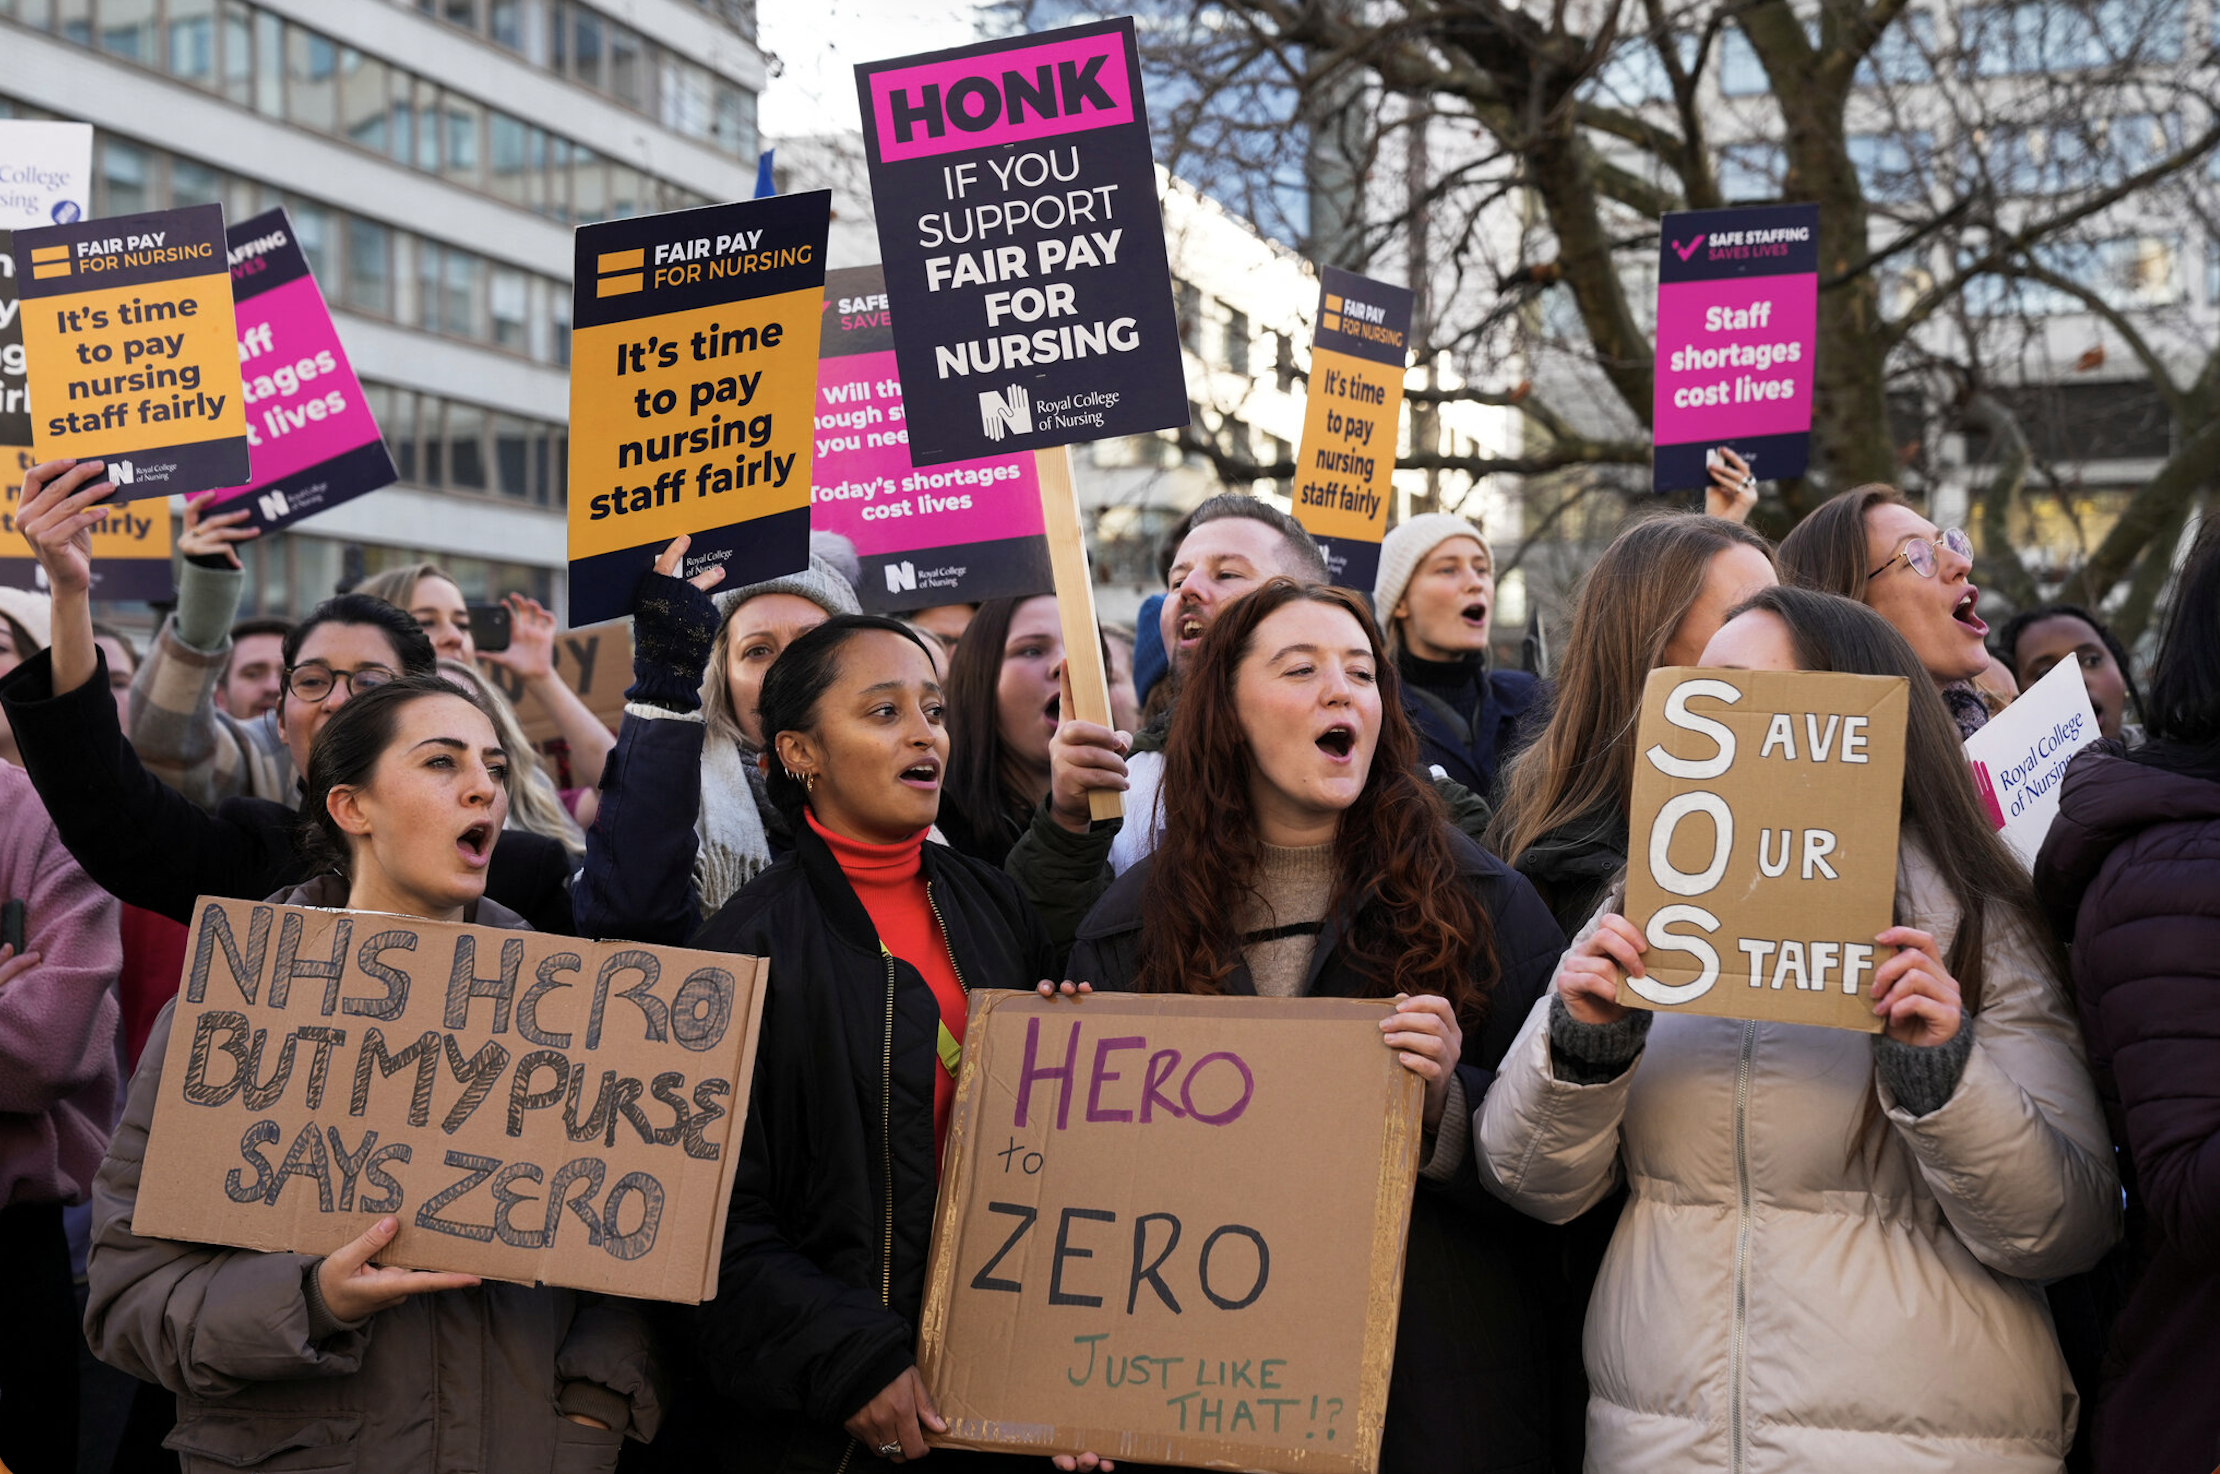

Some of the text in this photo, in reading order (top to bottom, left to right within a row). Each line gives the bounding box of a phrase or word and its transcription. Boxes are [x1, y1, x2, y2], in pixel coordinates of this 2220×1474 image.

[889, 54, 1118, 143] HONK
[944, 146, 1079, 200] IF YOU
[918, 184, 1118, 248] SUPPORT
[77, 232, 165, 257] FAIR PAY
[228, 230, 287, 265] AFFING
[655, 229, 763, 265] FAIR PAY
[1708, 243, 1788, 261] SAVES LIVES
[1709, 227, 1810, 247] SAFE STAFFING
[80, 243, 212, 273] FOR NURSING
[654, 244, 812, 289] FOR NURSING
[925, 228, 1123, 292] FAIR PAY
[119, 297, 198, 327] time
[838, 293, 889, 314] SAFE
[984, 283, 1078, 327] FOR
[1344, 298, 1386, 325] FAIR PAY
[1704, 301, 1772, 332] Staff
[841, 311, 891, 331] SAVE
[1342, 317, 1403, 348] FOR NURSING
[77, 333, 186, 365] to pay
[238, 321, 274, 363] aff
[691, 321, 783, 359] time
[934, 317, 1139, 379] NURSING
[1670, 342, 1802, 372] shortages
[69, 365, 200, 399] nursing
[242, 350, 337, 404] tages
[634, 371, 762, 417] to pay
[822, 379, 902, 404] Will th
[1350, 374, 1385, 405] time
[1674, 375, 1795, 409] cost lives
[49, 392, 227, 436] staff fairly
[262, 390, 347, 438] lives
[814, 405, 882, 429] nough
[1037, 390, 1120, 417] Royal College
[1038, 411, 1104, 431] of Nursing
[1327, 409, 1374, 446] to pay
[619, 413, 772, 468] nursing
[816, 429, 909, 458] you nee
[136, 463, 177, 476] Royal College
[144, 473, 169, 481] Nursing
[902, 463, 1020, 492] shortages
[1316, 449, 1375, 483] nursing
[589, 450, 796, 521] staff fairly
[1301, 482, 1381, 520] staff fairly
[862, 492, 973, 521] cost lives
[686, 567, 695, 577] of
[687, 549, 733, 566] Royal College
[918, 566, 967, 580] Royal College
[929, 578, 958, 588] Nursing
[2000, 712, 2084, 791] Royal College
[2010, 790, 2025, 818] of
[187, 904, 735, 1052] NHS HERO
[183, 1011, 730, 1161] BUT MY PURSE
[1014, 1017, 1254, 1130] HERO
[998, 1136, 1044, 1175] to
[224, 1120, 665, 1261] SAYS ZERO
[970, 1201, 1270, 1315] ZERO
[1068, 1333, 1287, 1389] JUST LIKE
